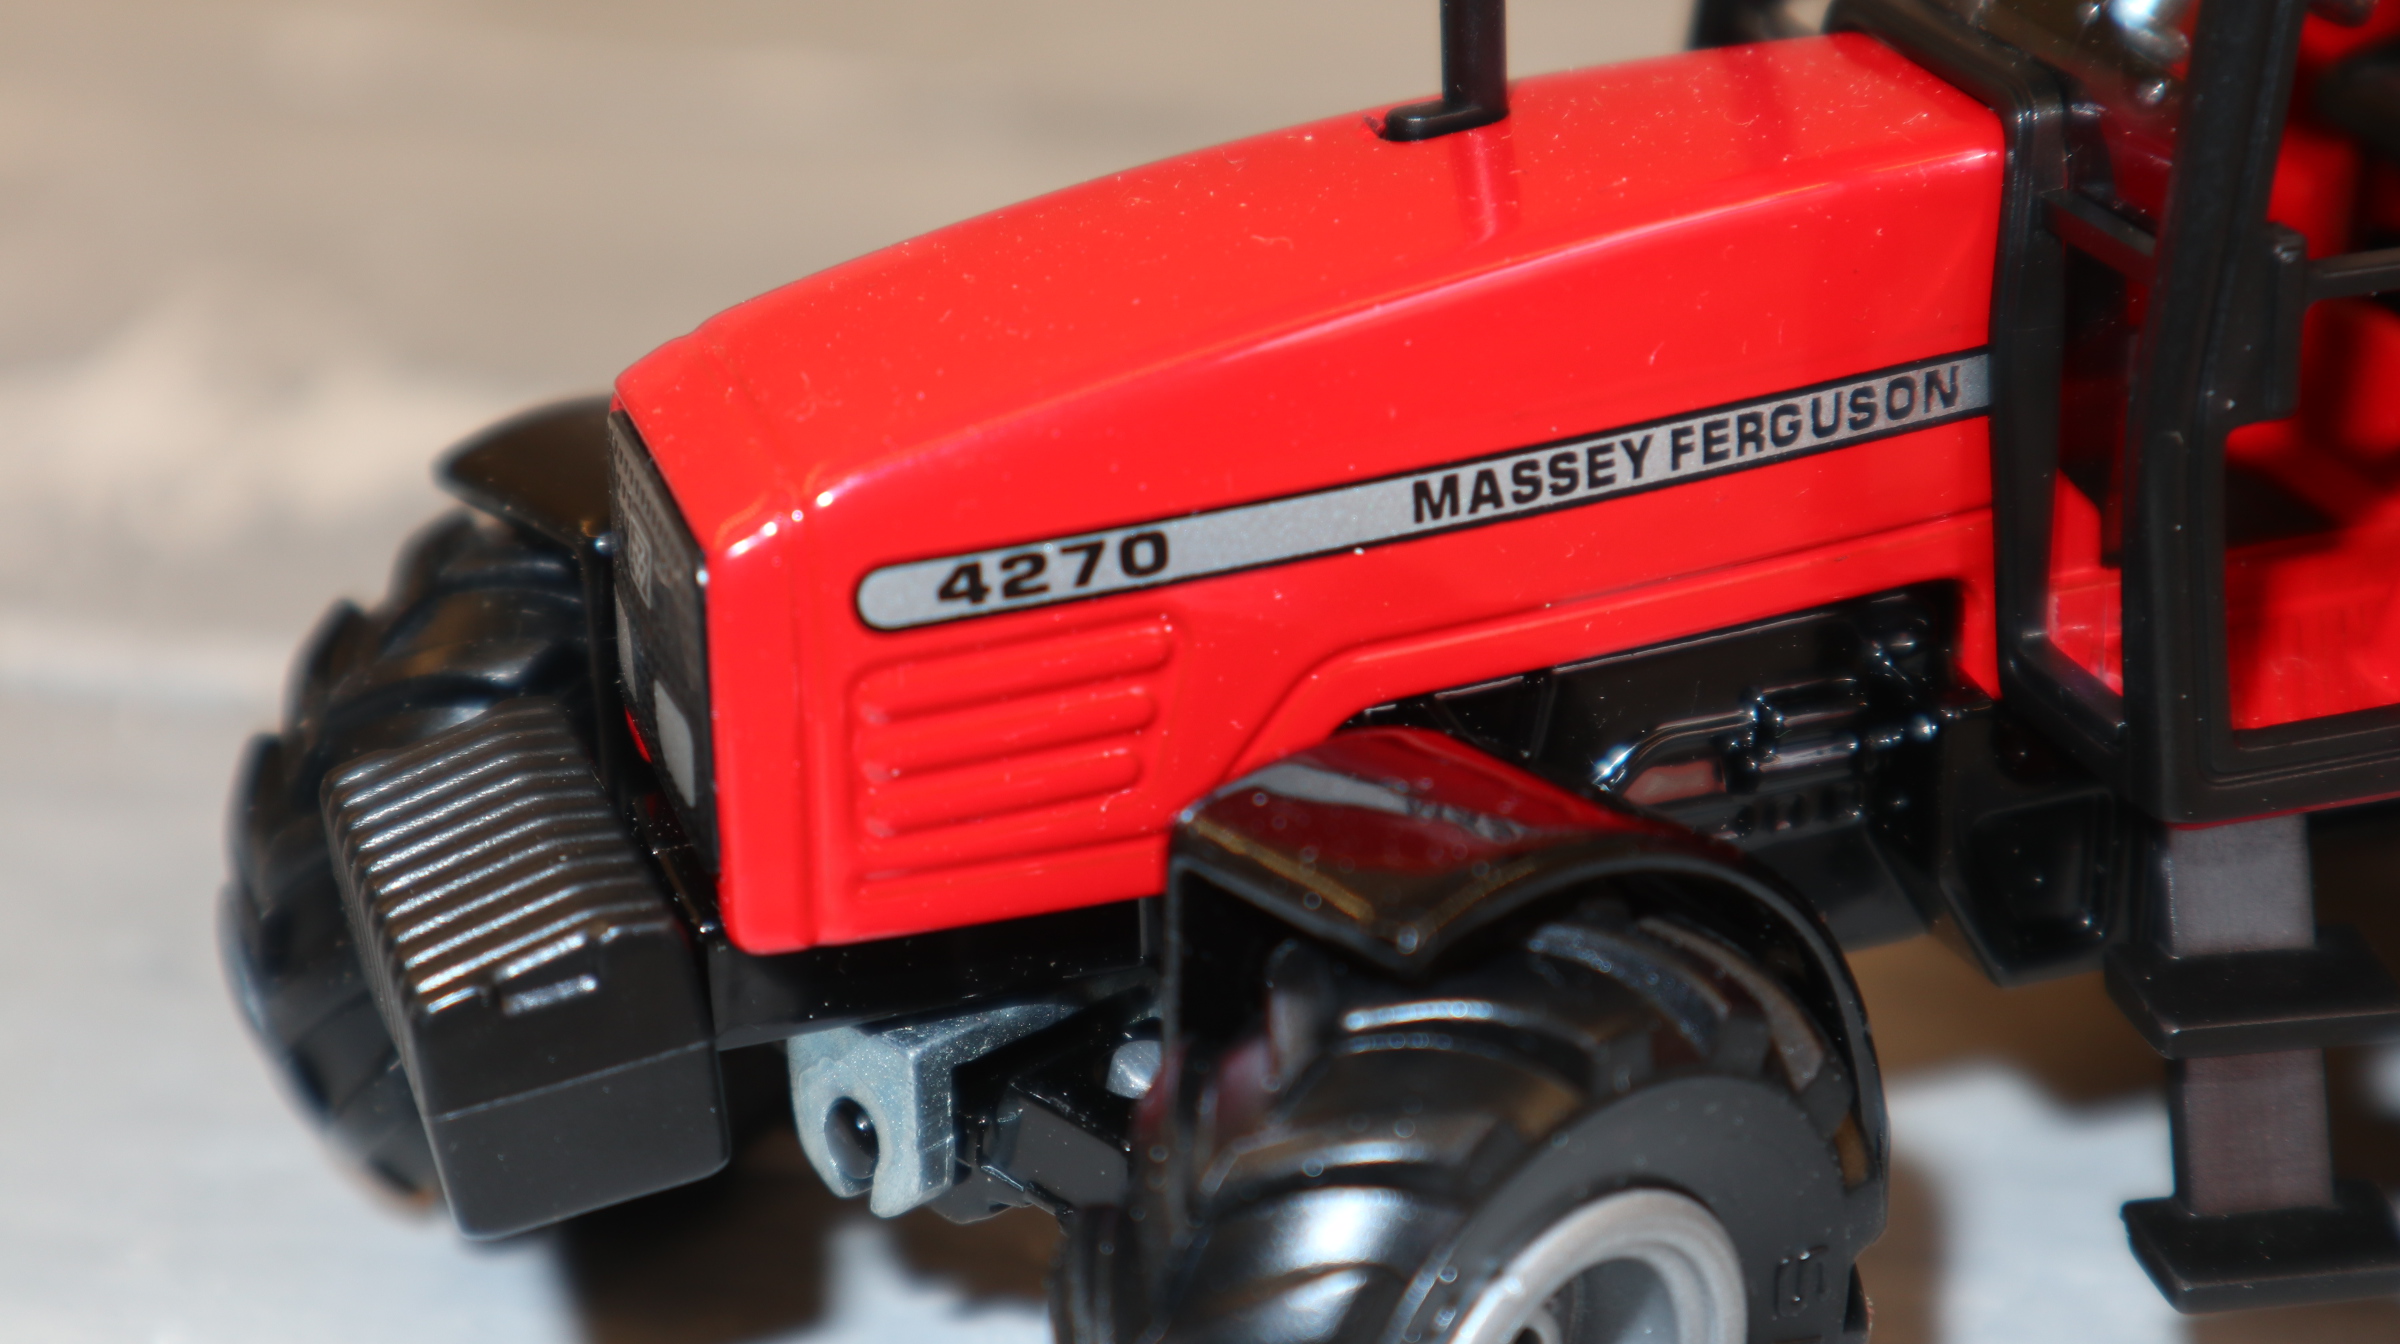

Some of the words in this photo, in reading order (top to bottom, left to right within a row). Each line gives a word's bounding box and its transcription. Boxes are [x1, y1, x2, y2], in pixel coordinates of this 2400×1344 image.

[1412, 434, 1654, 525] MASSEY
[1670, 366, 1960, 470] FERGUSON
[937, 530, 1168, 605] 4270
